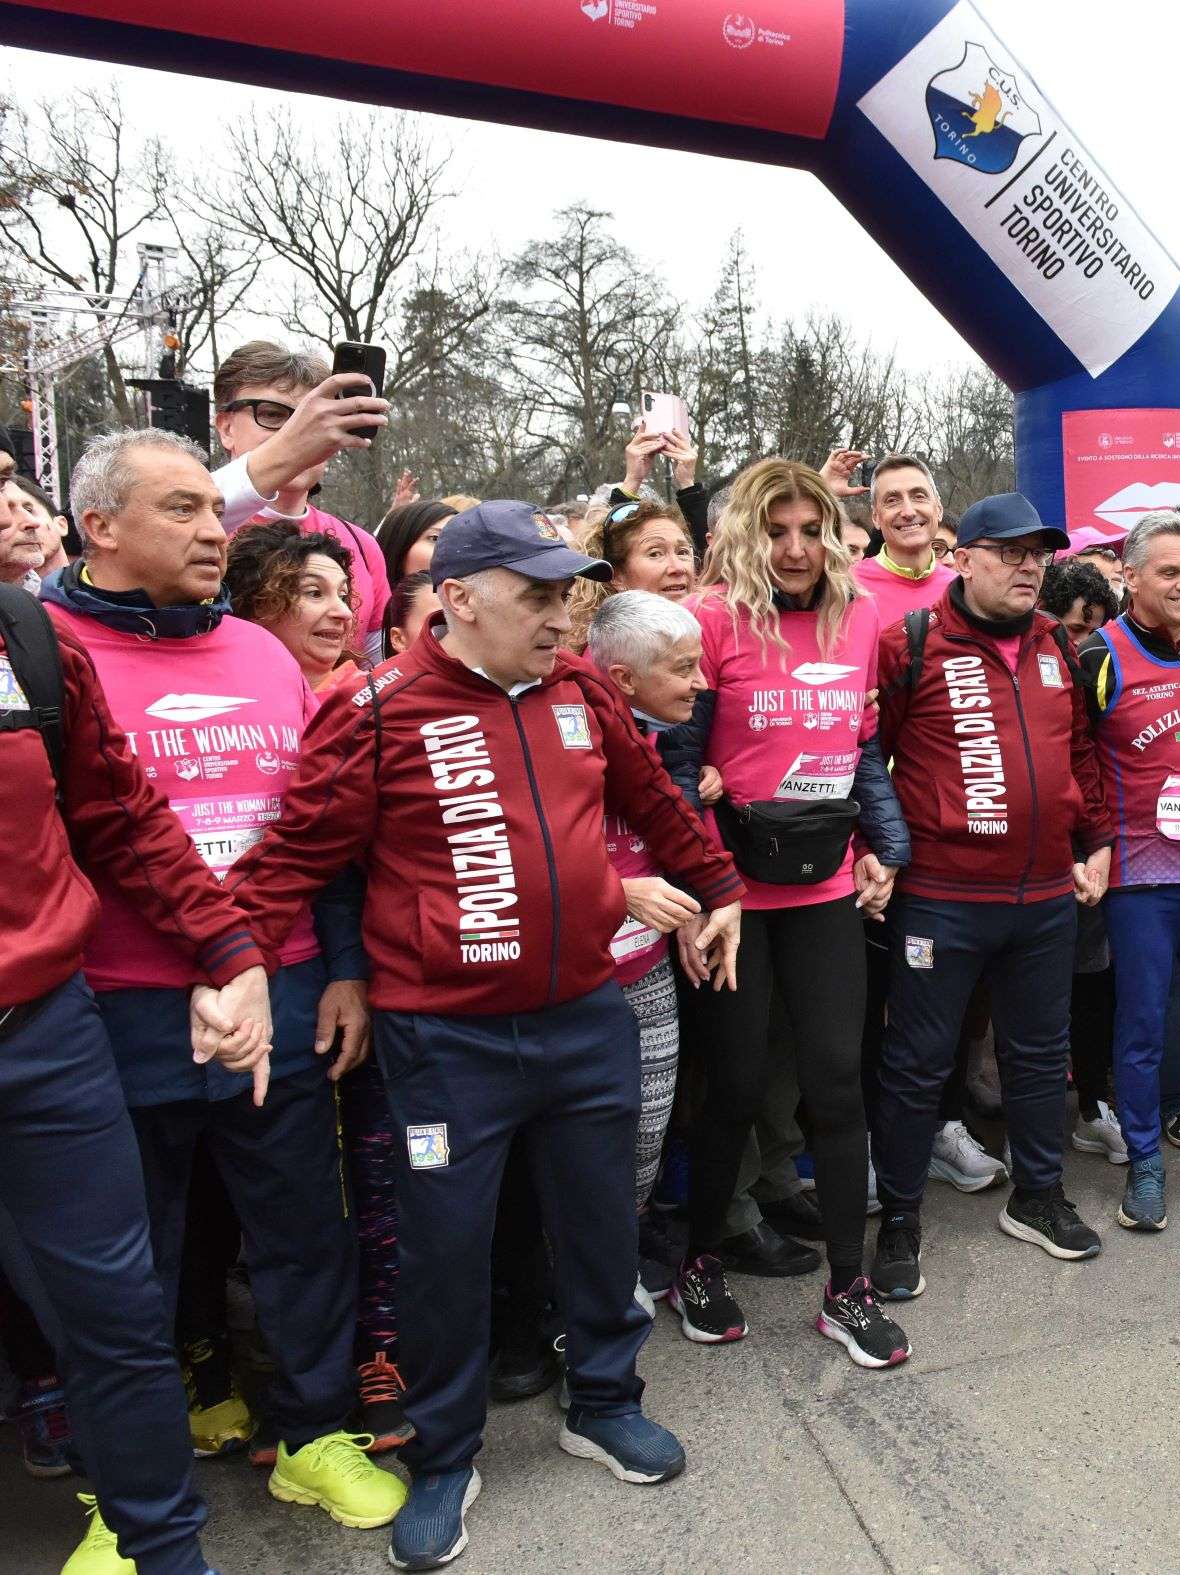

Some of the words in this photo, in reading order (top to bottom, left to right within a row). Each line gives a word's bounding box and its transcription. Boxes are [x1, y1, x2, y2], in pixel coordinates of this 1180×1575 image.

[988, 66, 1021, 110] C.U.S.
[934, 113, 976, 164] TORINO
[1060, 148, 1119, 222] CENTRO
[1000, 204, 1065, 281] TORINO
[1023, 184, 1103, 280] SPORTIVO
[1044, 163, 1155, 301] UNIVERSITARIO
[748, 690, 786, 713] JUST
[790, 689, 815, 711] THE
[817, 689, 858, 712] WOMAN
[942, 656, 992, 709] STATO
[1132, 687, 1148, 696] SEZ.
[1146, 691, 1174, 700] TORINO
[147, 728, 191, 758] THE
[192, 725, 267, 754] WOMAN
[268, 724, 280, 750] I
[282, 725, 299, 754] AM
[953, 711, 996, 734] DI
[419, 714, 496, 790] STATO
[958, 735, 1008, 811] POLIZIA
[192, 802, 215, 817] JUST
[217, 800, 233, 815] THE
[236, 799, 266, 814] WOMAN
[223, 814, 256, 824] MARZO
[438, 791, 504, 825] DI
[967, 820, 1008, 835] TORINO
[447, 822, 520, 930] POLIZIA
[460, 941, 521, 964] TORINO
